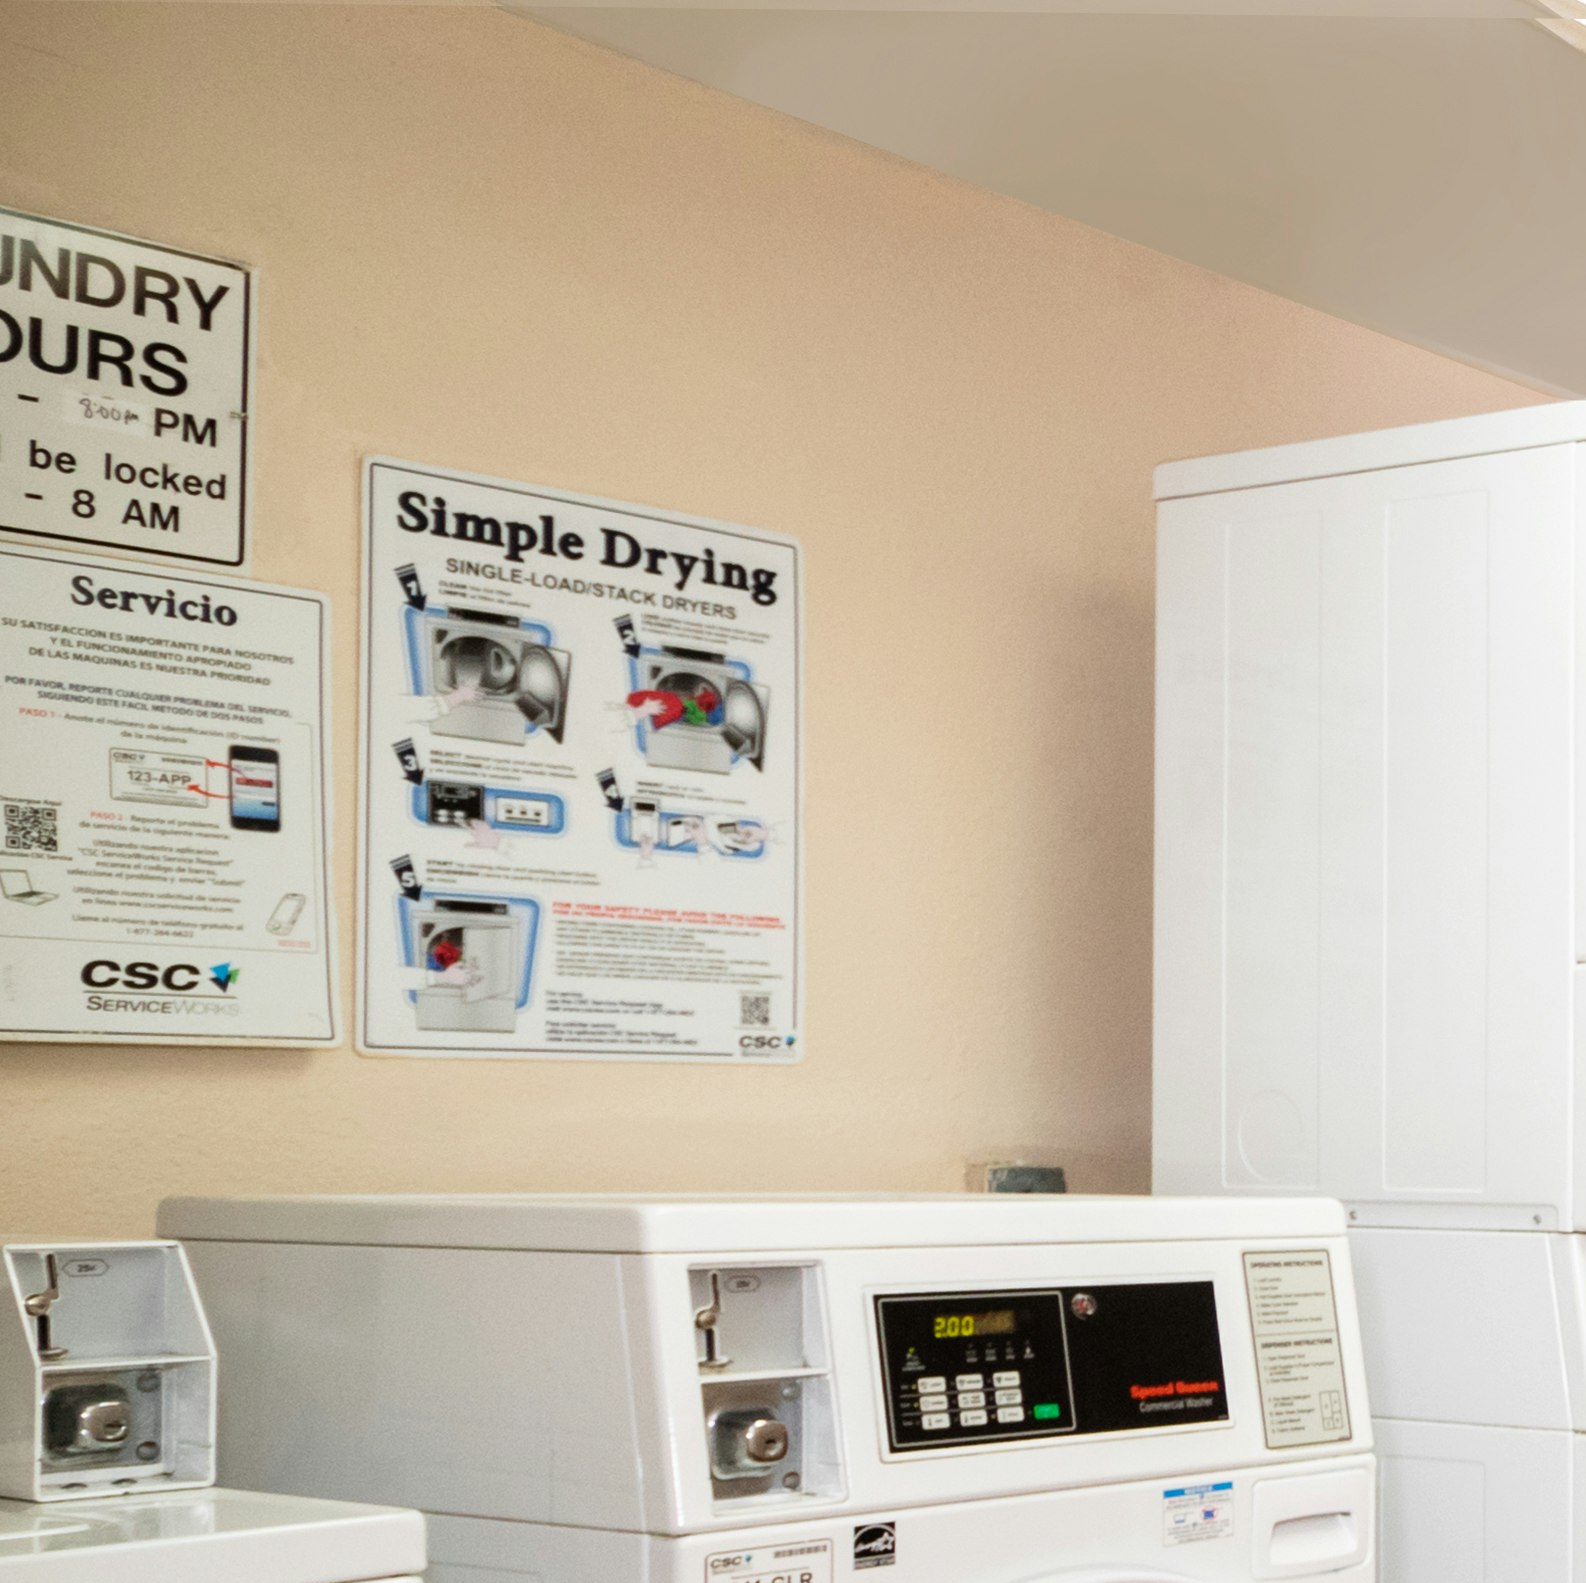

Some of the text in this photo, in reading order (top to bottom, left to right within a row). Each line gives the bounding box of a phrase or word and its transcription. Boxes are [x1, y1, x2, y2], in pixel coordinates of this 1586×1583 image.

[154, 407, 217, 448] PM
[29, 439, 227, 501] be locked
[72, 489, 96, 519] 8
[121, 499, 180, 533] AM
[397, 490, 778, 606] Simple Drying
[70, 575, 237, 627] Servicio
[407, 581, 418, 596] 1
[446, 557, 656, 607] SINGLE-LOAD/STACK
[660, 588, 738, 620] DRYERS
[29, 647, 44, 657] DE
[47, 649, 70, 660] LAS
[126, 635, 199, 651] IMPORTANTE
[202, 645, 232, 656] PARA
[235, 650, 294, 665] NOSOTROS
[128, 770, 191, 785] 123-APP
[404, 755, 416, 771] 3
[403, 872, 415, 887] 5
[81, 960, 200, 991] CSC
[739, 1036, 782, 1048] CSC
[710, 1556, 742, 1569] CSC
